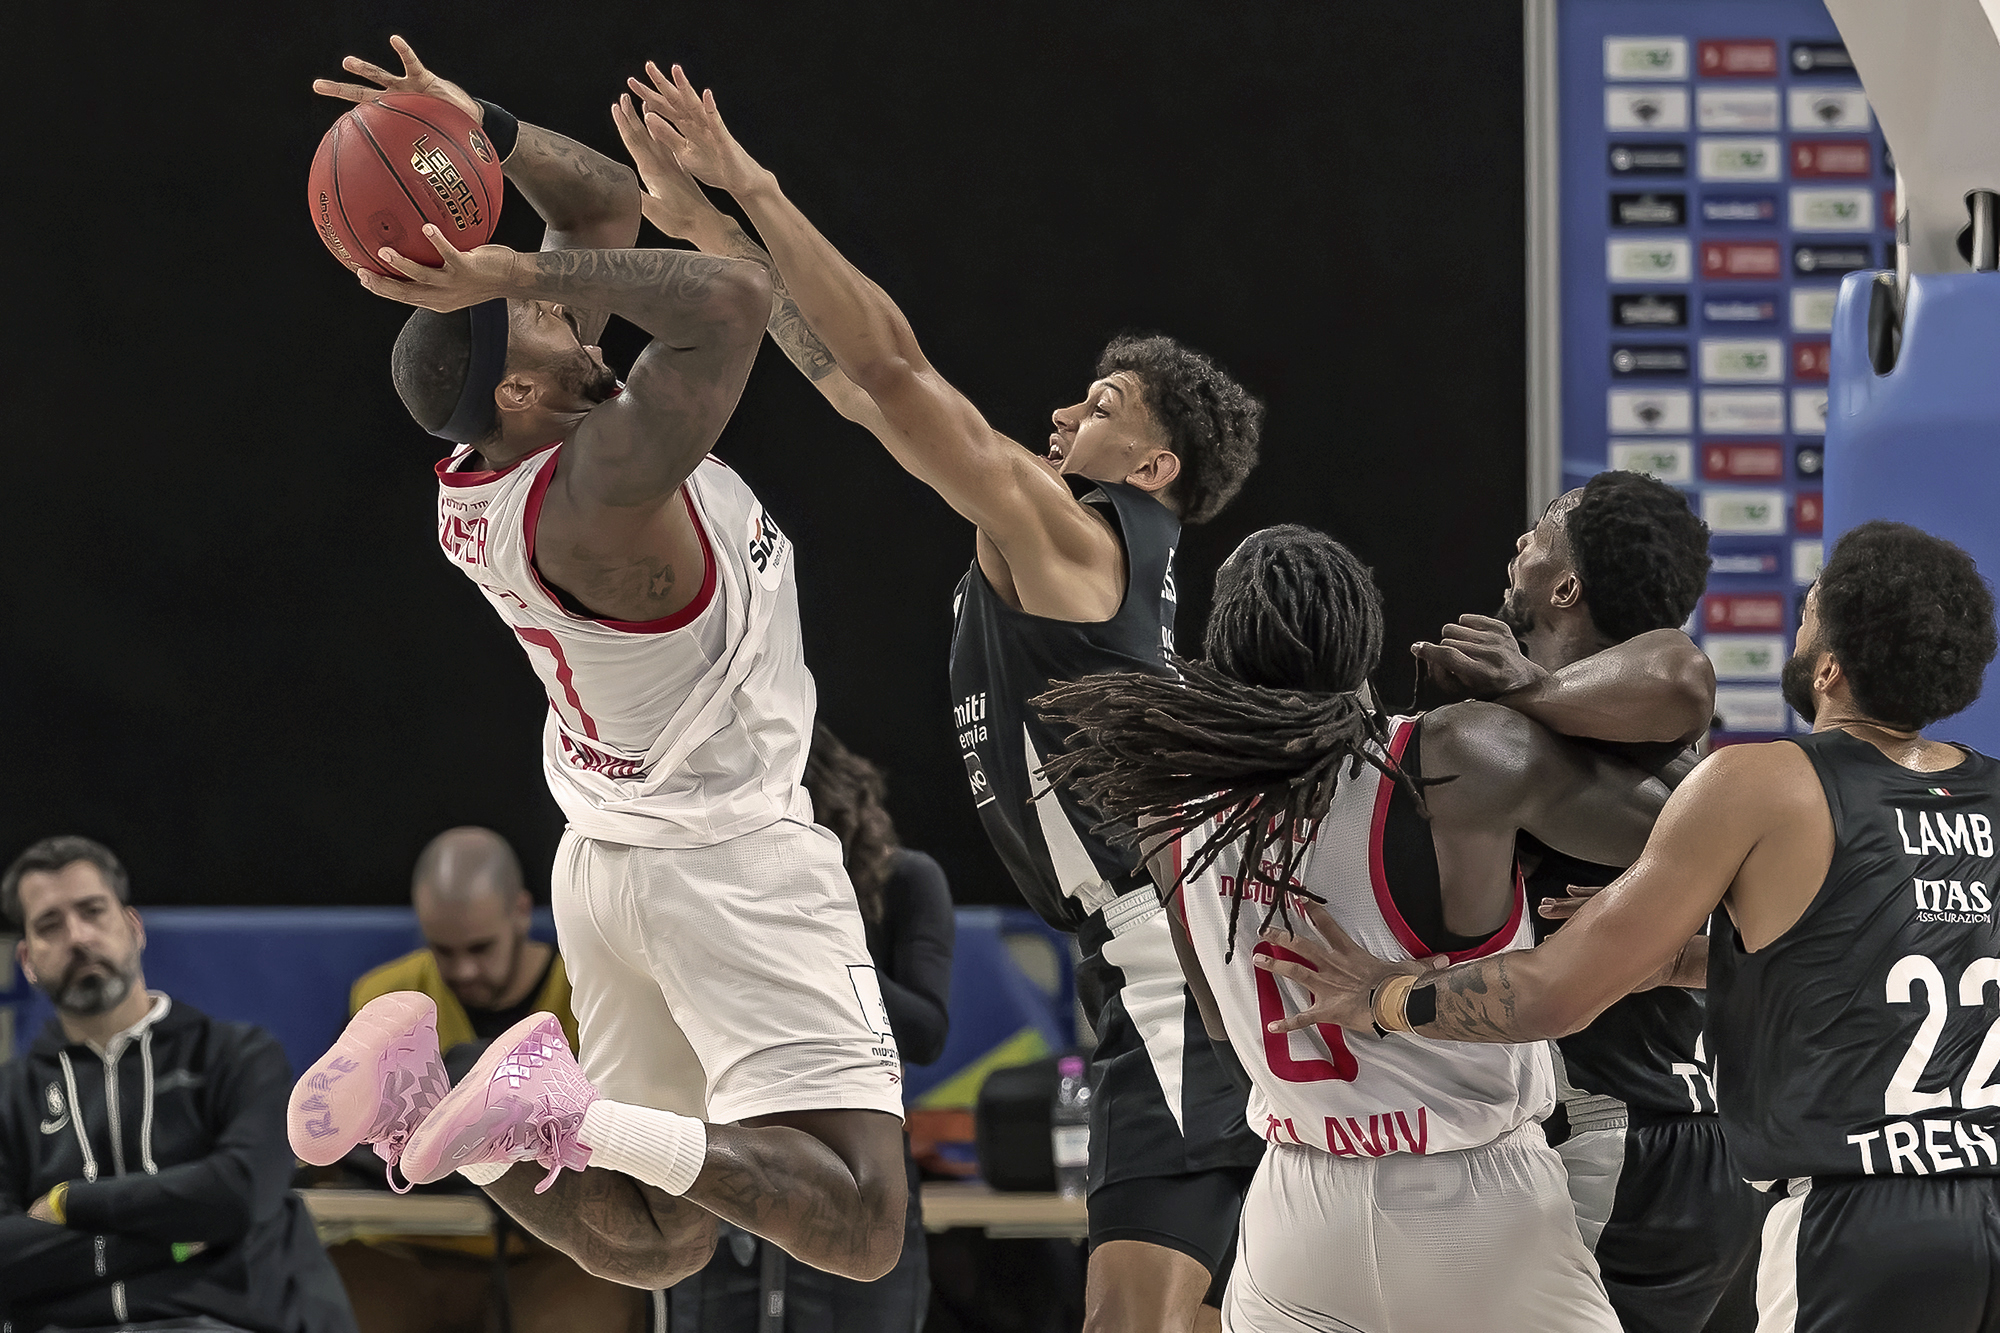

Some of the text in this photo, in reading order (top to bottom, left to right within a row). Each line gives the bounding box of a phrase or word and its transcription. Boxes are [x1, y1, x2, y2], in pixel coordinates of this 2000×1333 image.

[412, 133, 483, 226] LEGACY
[1895, 807, 1994, 858] LAMB
[1913, 877, 1993, 913] ITAS
[1884, 954, 2000, 1115] 22
[1324, 1106, 1428, 1157] AVIV
